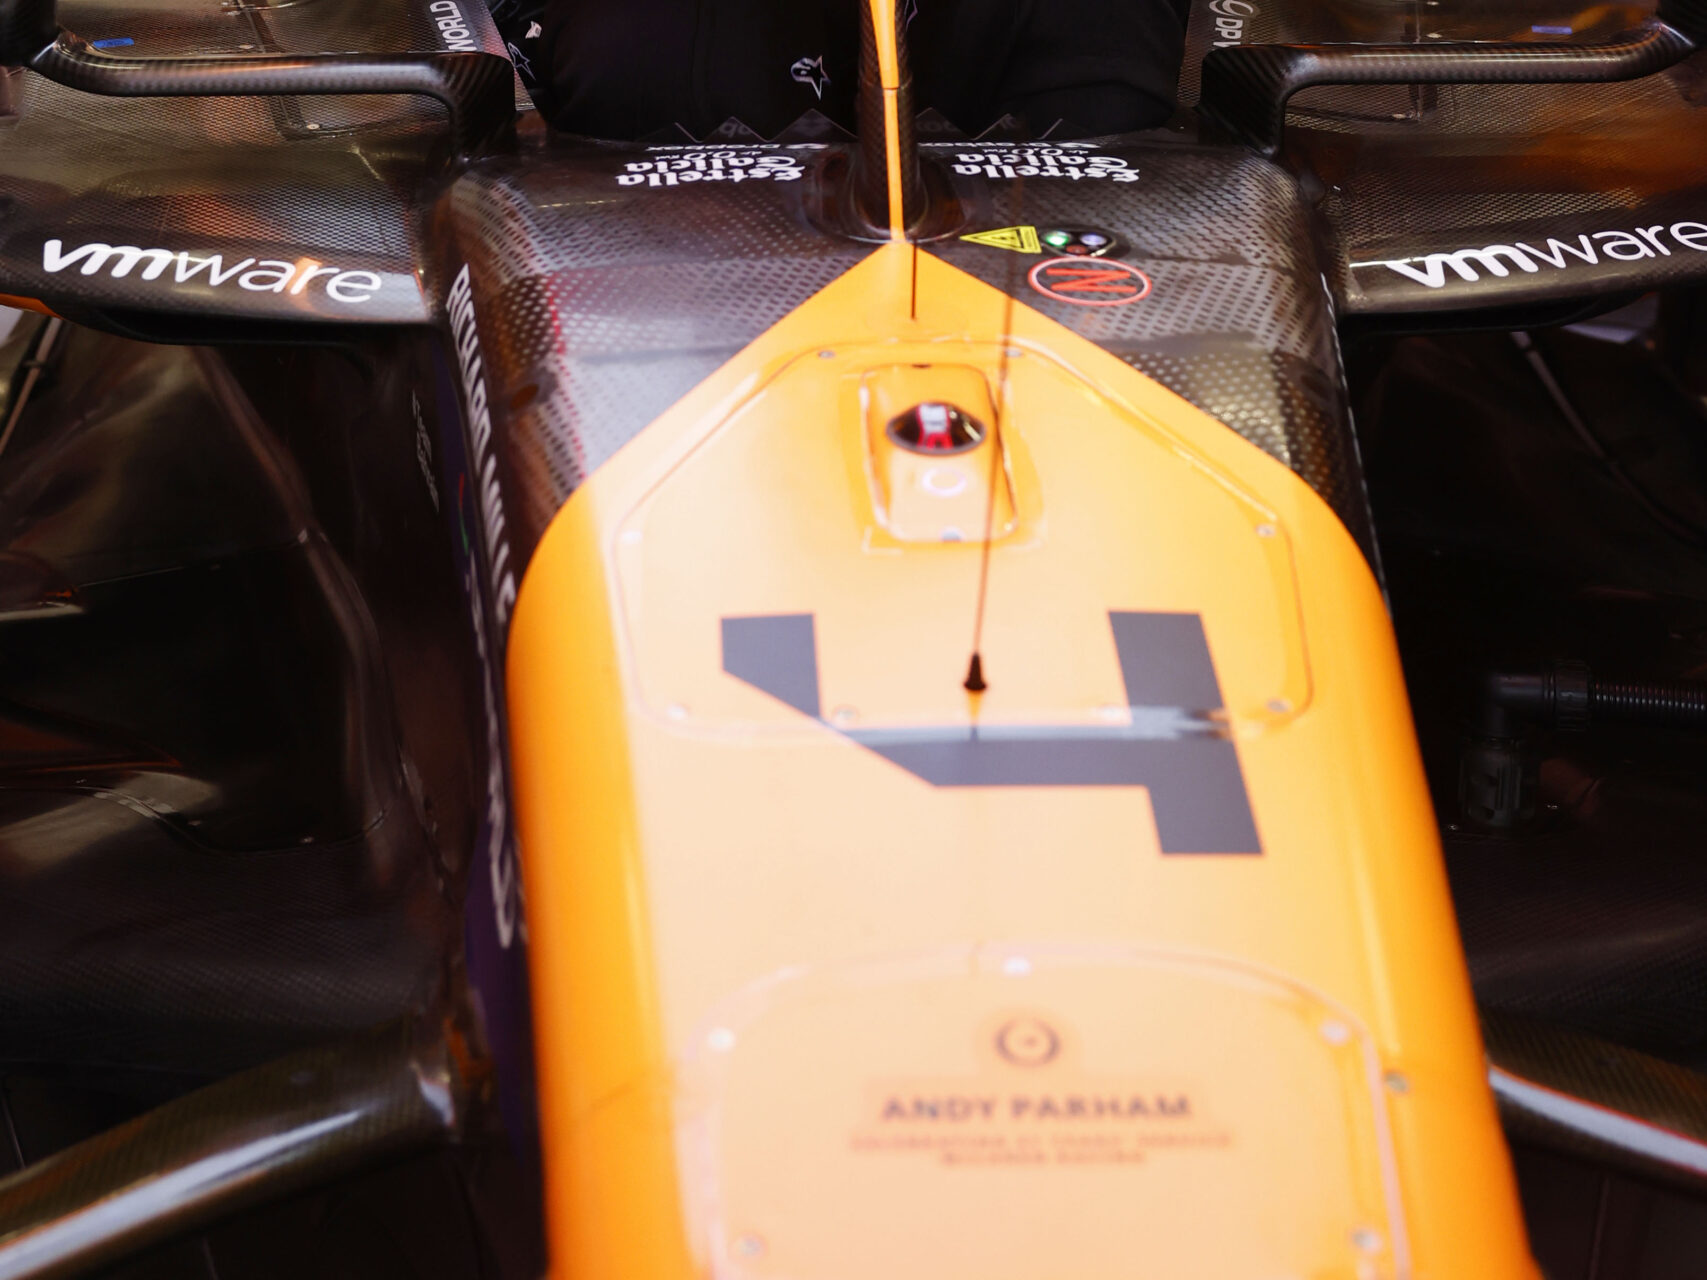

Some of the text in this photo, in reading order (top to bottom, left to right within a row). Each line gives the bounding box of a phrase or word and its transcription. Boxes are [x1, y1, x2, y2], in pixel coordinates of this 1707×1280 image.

[429, 0, 478, 52] WORLD
[615, 166, 806, 187] Estrella
[624, 155, 797, 173] Galicia
[951, 163, 1140, 182] Estrella
[955, 153, 1129, 168] Galicia
[42, 239, 382, 303] vmware
[1385, 221, 1707, 288] vmware
[446, 263, 491, 474] RICHARD
[720, 609, 1264, 856] 4
[883, 1094, 1193, 1120] ANDY PARHAM
